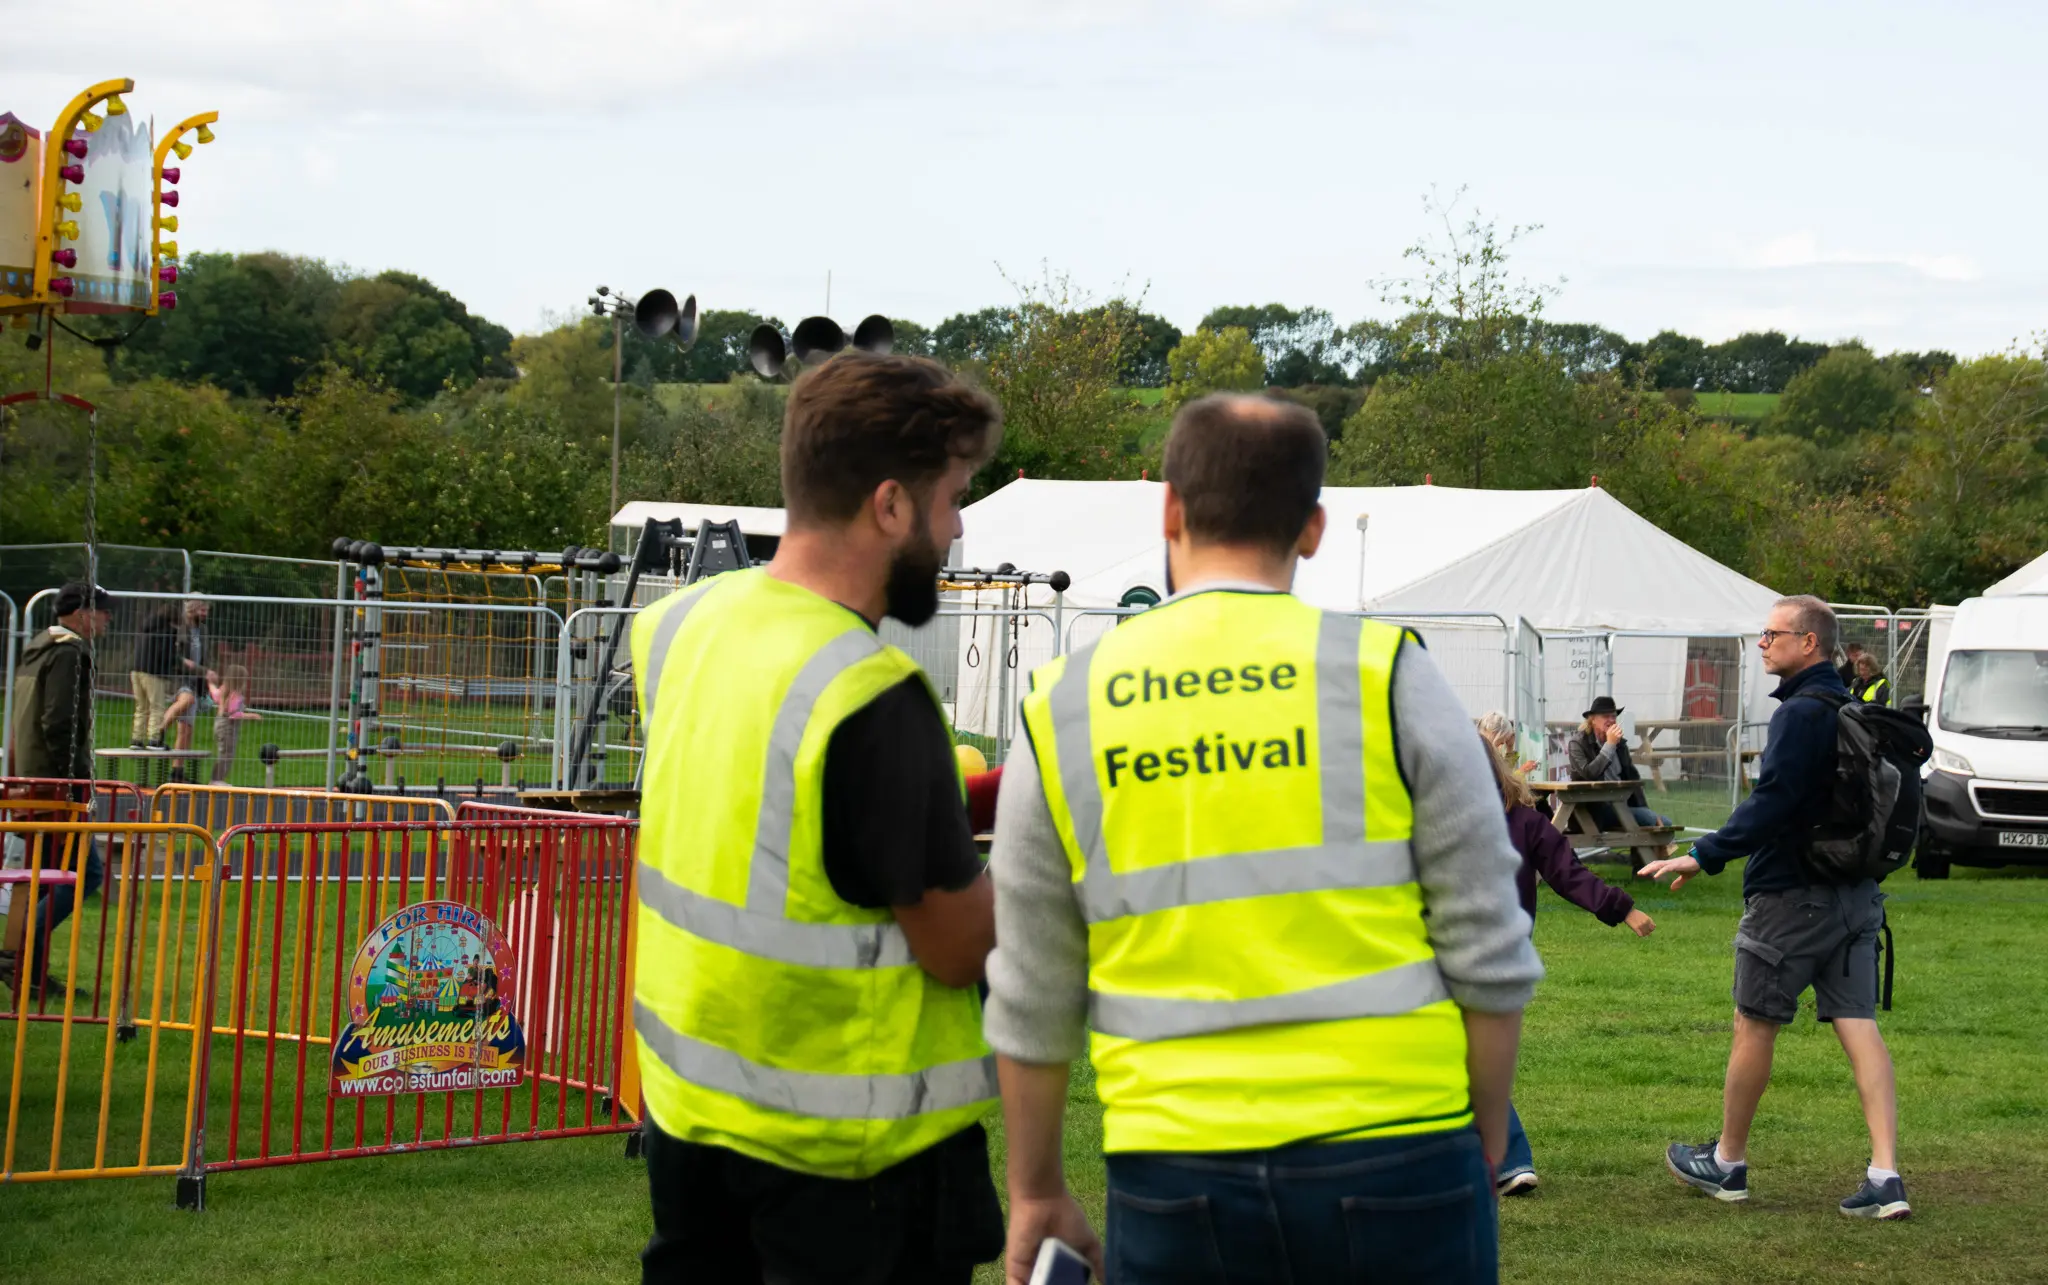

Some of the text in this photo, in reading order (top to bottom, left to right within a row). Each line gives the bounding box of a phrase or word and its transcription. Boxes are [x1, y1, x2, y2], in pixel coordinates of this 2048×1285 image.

[1106, 662, 1297, 708] Cheese
[1104, 725, 1307, 788] Festival
[2002, 832, 2034, 845] HX20
[380, 907, 428, 942] FOR
[343, 1006, 511, 1052] Amusements
[362, 1056, 389, 1073] OUR
[393, 1045, 450, 1064] BUSINESS
[454, 1046, 466, 1058] IS
[340, 1068, 517, 1095] www.coesfunfaicom
